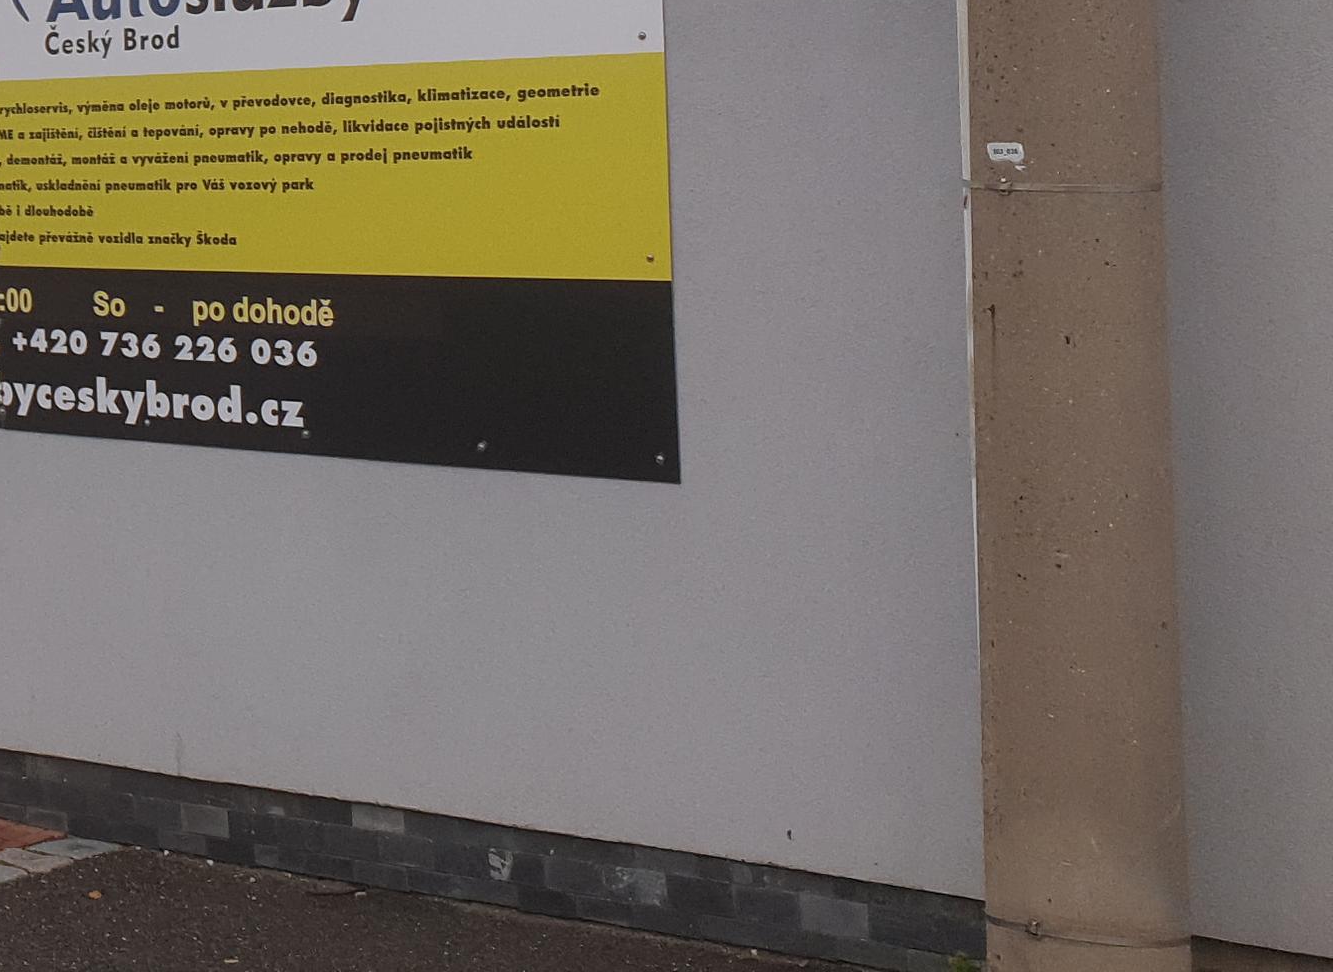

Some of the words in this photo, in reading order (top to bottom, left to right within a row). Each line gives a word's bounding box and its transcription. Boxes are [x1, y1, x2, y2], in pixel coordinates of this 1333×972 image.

[45, 25, 113, 58] Český
[123, 25, 180, 51] Brod
[77, 99, 124, 114] výměna
[129, 99, 161, 113] oleje
[165, 97, 215, 112] motorů,
[220, 97, 228, 108] v
[233, 94, 316, 109] převodovce,
[321, 90, 412, 107] diagnostika,
[417, 87, 511, 103] klimatizace,
[517, 84, 600, 102] geometrie
[18, 131, 25, 140] a
[130, 129, 138, 138] a
[143, 124, 203, 139] tepování,
[209, 121, 255, 138] opravy
[260, 124, 276, 137] po
[281, 120, 337, 136] nehodě,
[342, 119, 409, 133] likvidace
[415, 116, 491, 134] pojistných
[497, 114, 561, 129] událostí
[7, 153, 67, 167] demontáž,
[71, 153, 116, 165] montáž
[120, 156, 128, 164] a
[193, 150, 269, 164] pneumatik,
[274, 151, 321, 164] opravy
[327, 152, 335, 162] a
[341, 148, 387, 164] prodej
[393, 146, 473, 163] pneumatik
[36, 180, 101, 191] uskladnění
[105, 179, 171, 193] pneumatik
[176, 180, 198, 194] pro
[202, 178, 225, 191] Váš
[230, 179, 277, 193] vozový
[282, 178, 314, 193] park
[16, 205, 20, 216] i
[98, 231, 143, 245] vozidla
[148, 233, 191, 248] značky
[196, 231, 238, 246] Škoda
[93, 290, 126, 317] So
[193, 300, 225, 326] po
[233, 297, 334, 326] dohodě
[12, 327, 88, 355] +420
[100, 331, 161, 358] 736
[174, 334, 237, 362] 226
[250, 338, 318, 367] 036
